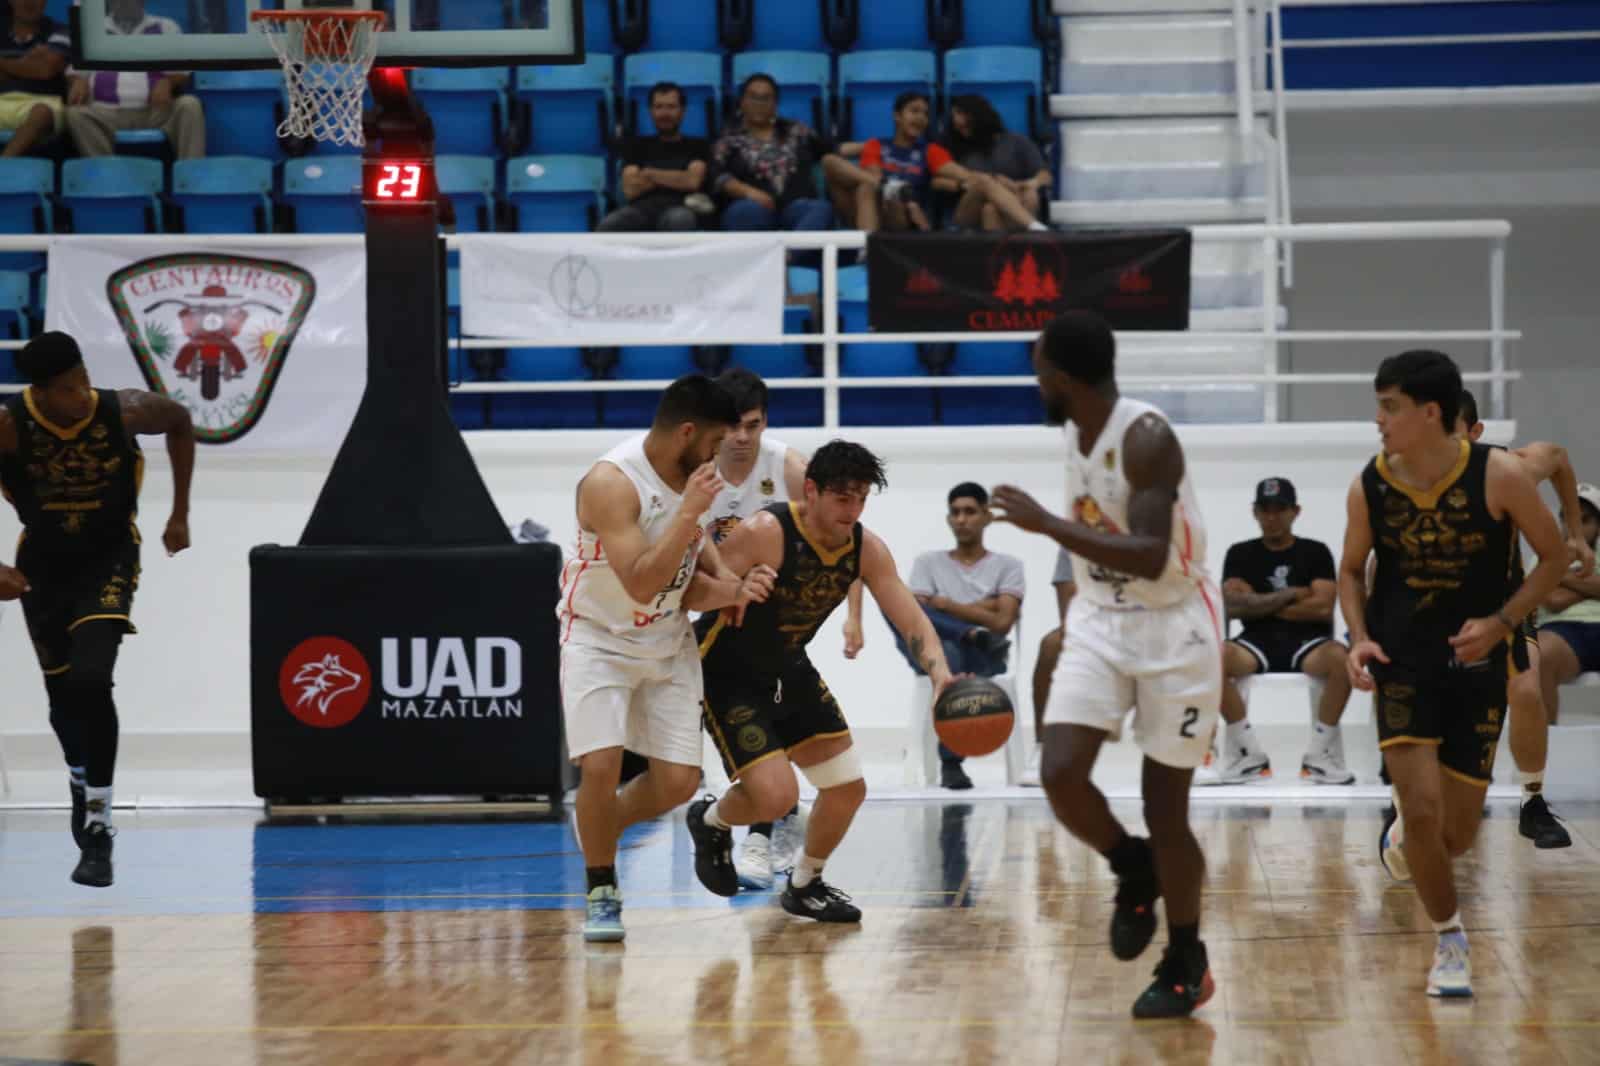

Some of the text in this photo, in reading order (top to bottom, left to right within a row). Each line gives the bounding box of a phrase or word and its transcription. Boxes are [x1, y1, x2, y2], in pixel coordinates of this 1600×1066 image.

[376, 165, 421, 197] 23
[129, 263, 296, 304] CENTAUROS
[381, 637, 522, 697] UAD
[1179, 707, 1200, 738] 2
